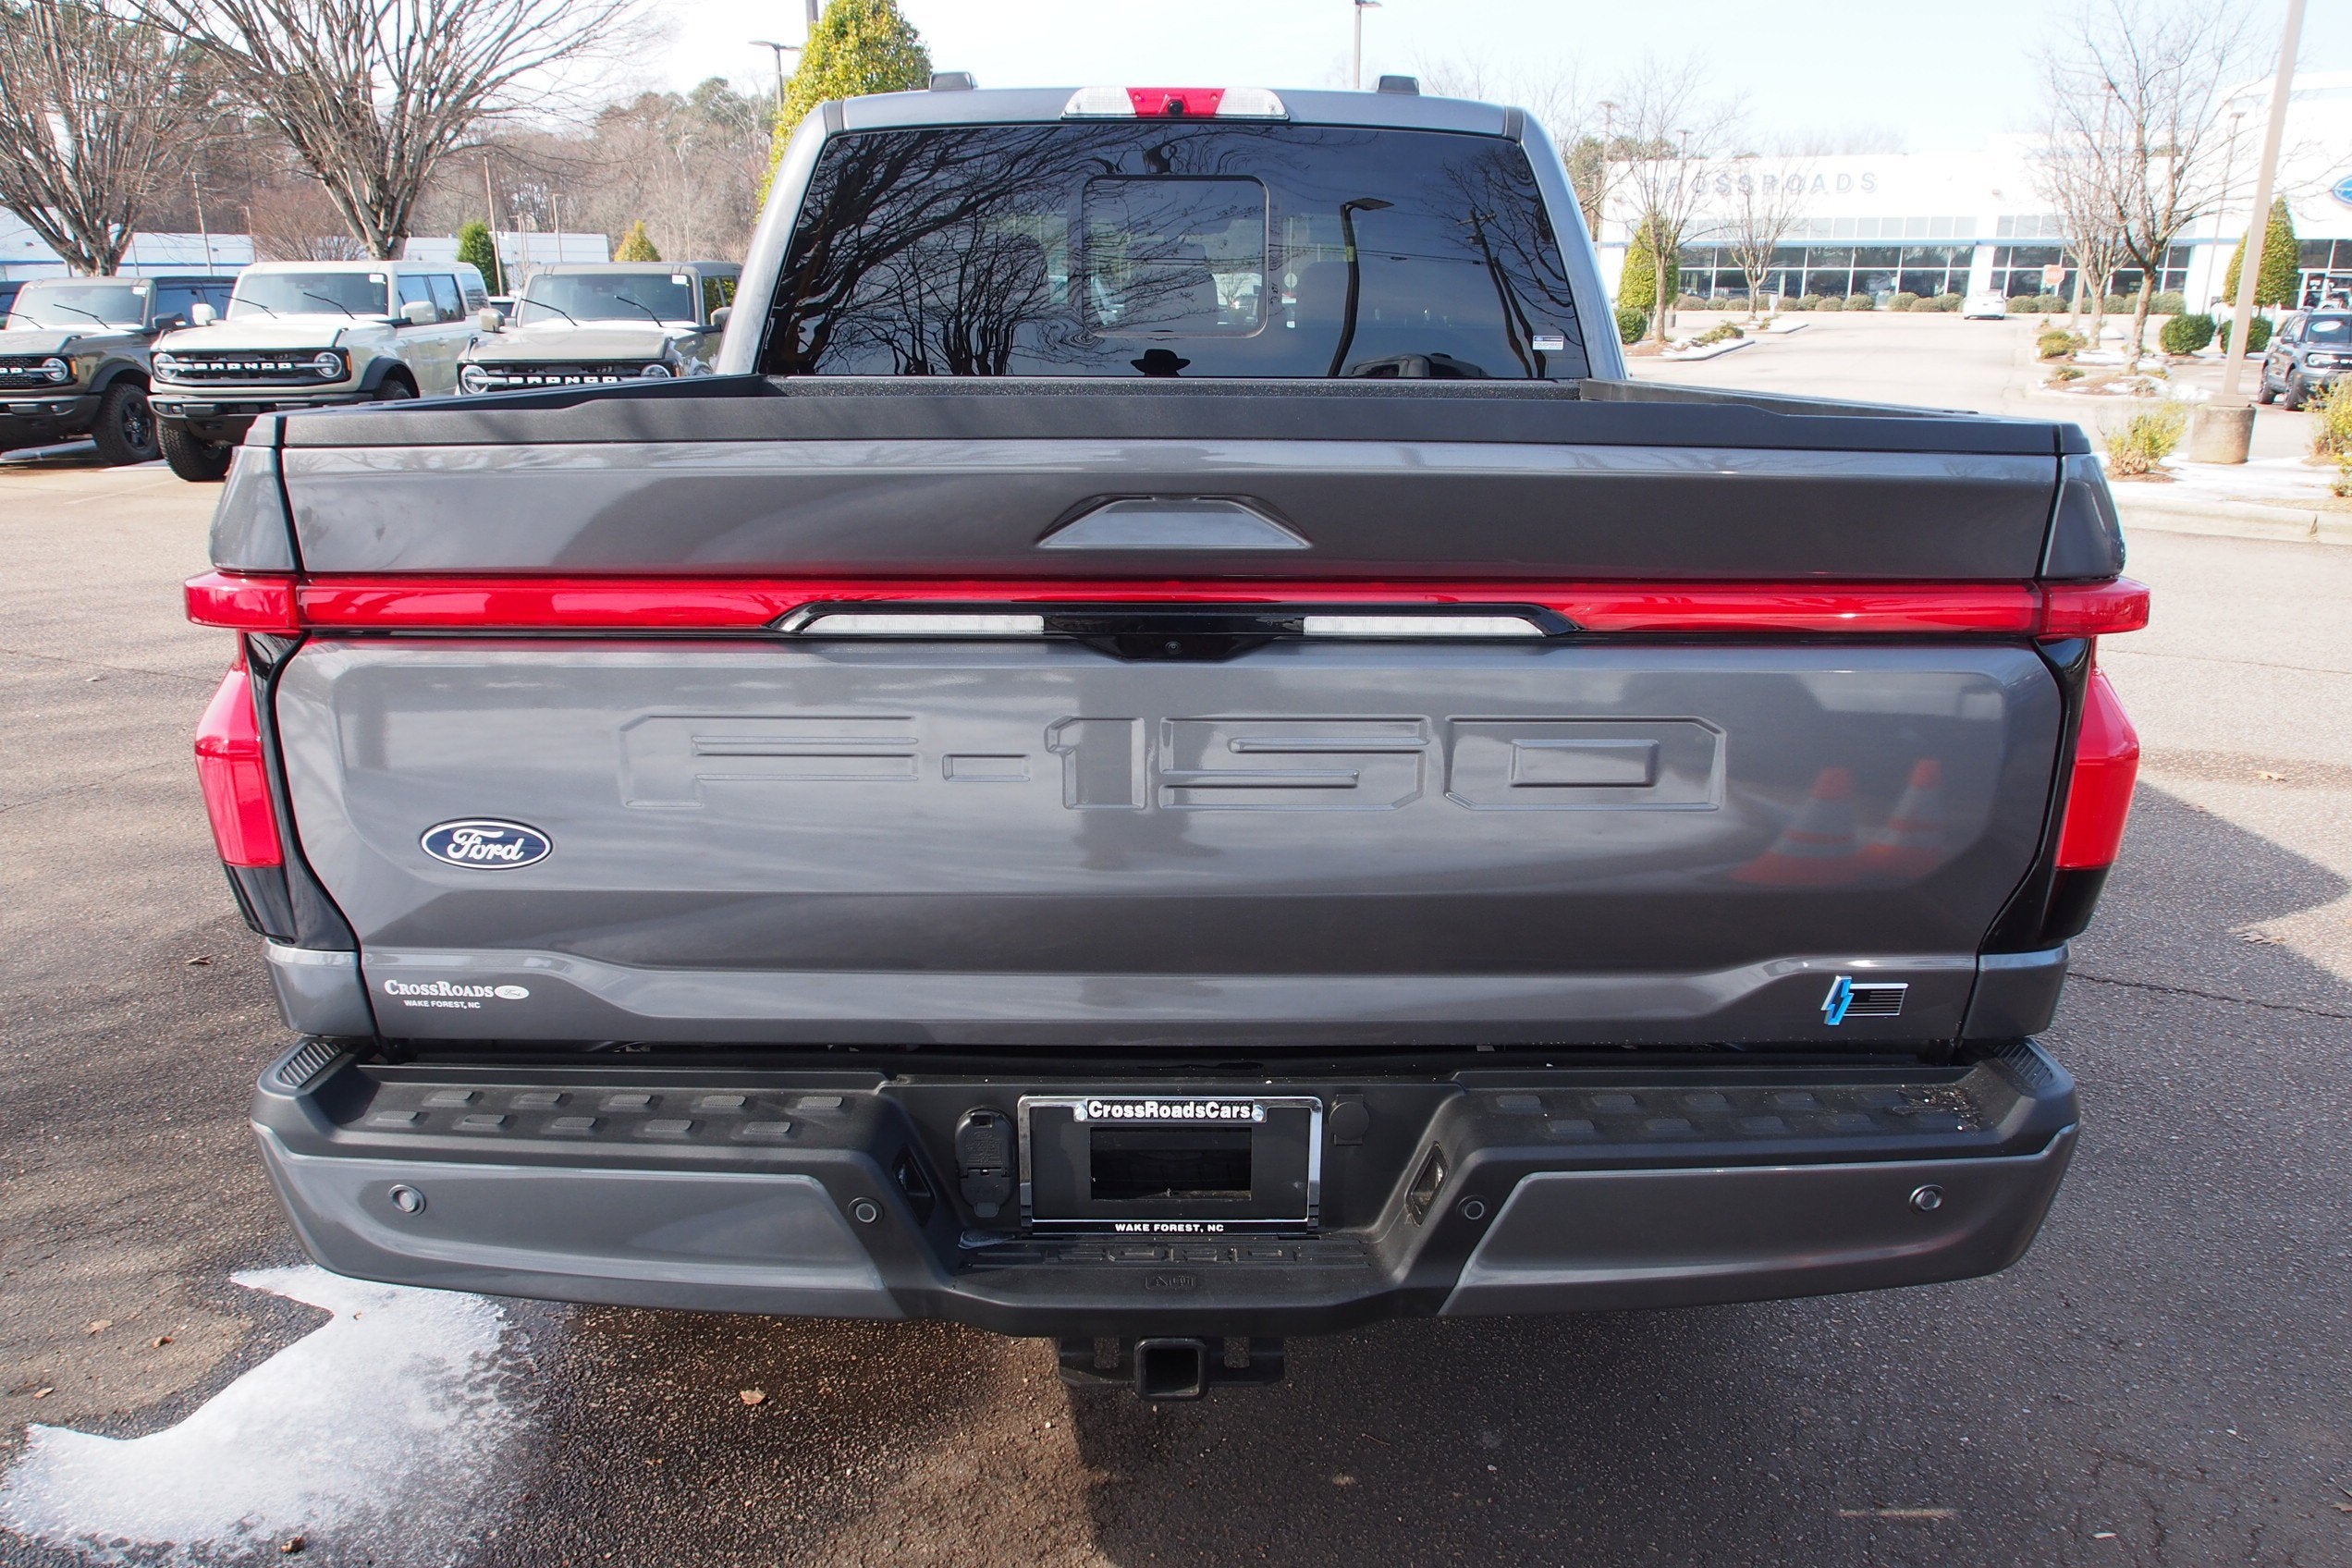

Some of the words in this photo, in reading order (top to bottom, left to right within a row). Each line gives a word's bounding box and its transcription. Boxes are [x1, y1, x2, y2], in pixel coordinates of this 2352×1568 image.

[193, 361, 292, 371] BRONCO
[508, 375, 619, 385] BRONCO
[619, 713, 1728, 812] F-150
[447, 827, 525, 862] Ford
[403, 999, 429, 1008] WAKE
[431, 1000, 467, 1009] FOREST,
[1088, 1100, 1251, 1119] CrossRoadsCars
[1114, 1223, 1150, 1232] WAKE
[1153, 1223, 1204, 1233] FOREST,
[1207, 1223, 1224, 1232] NC
